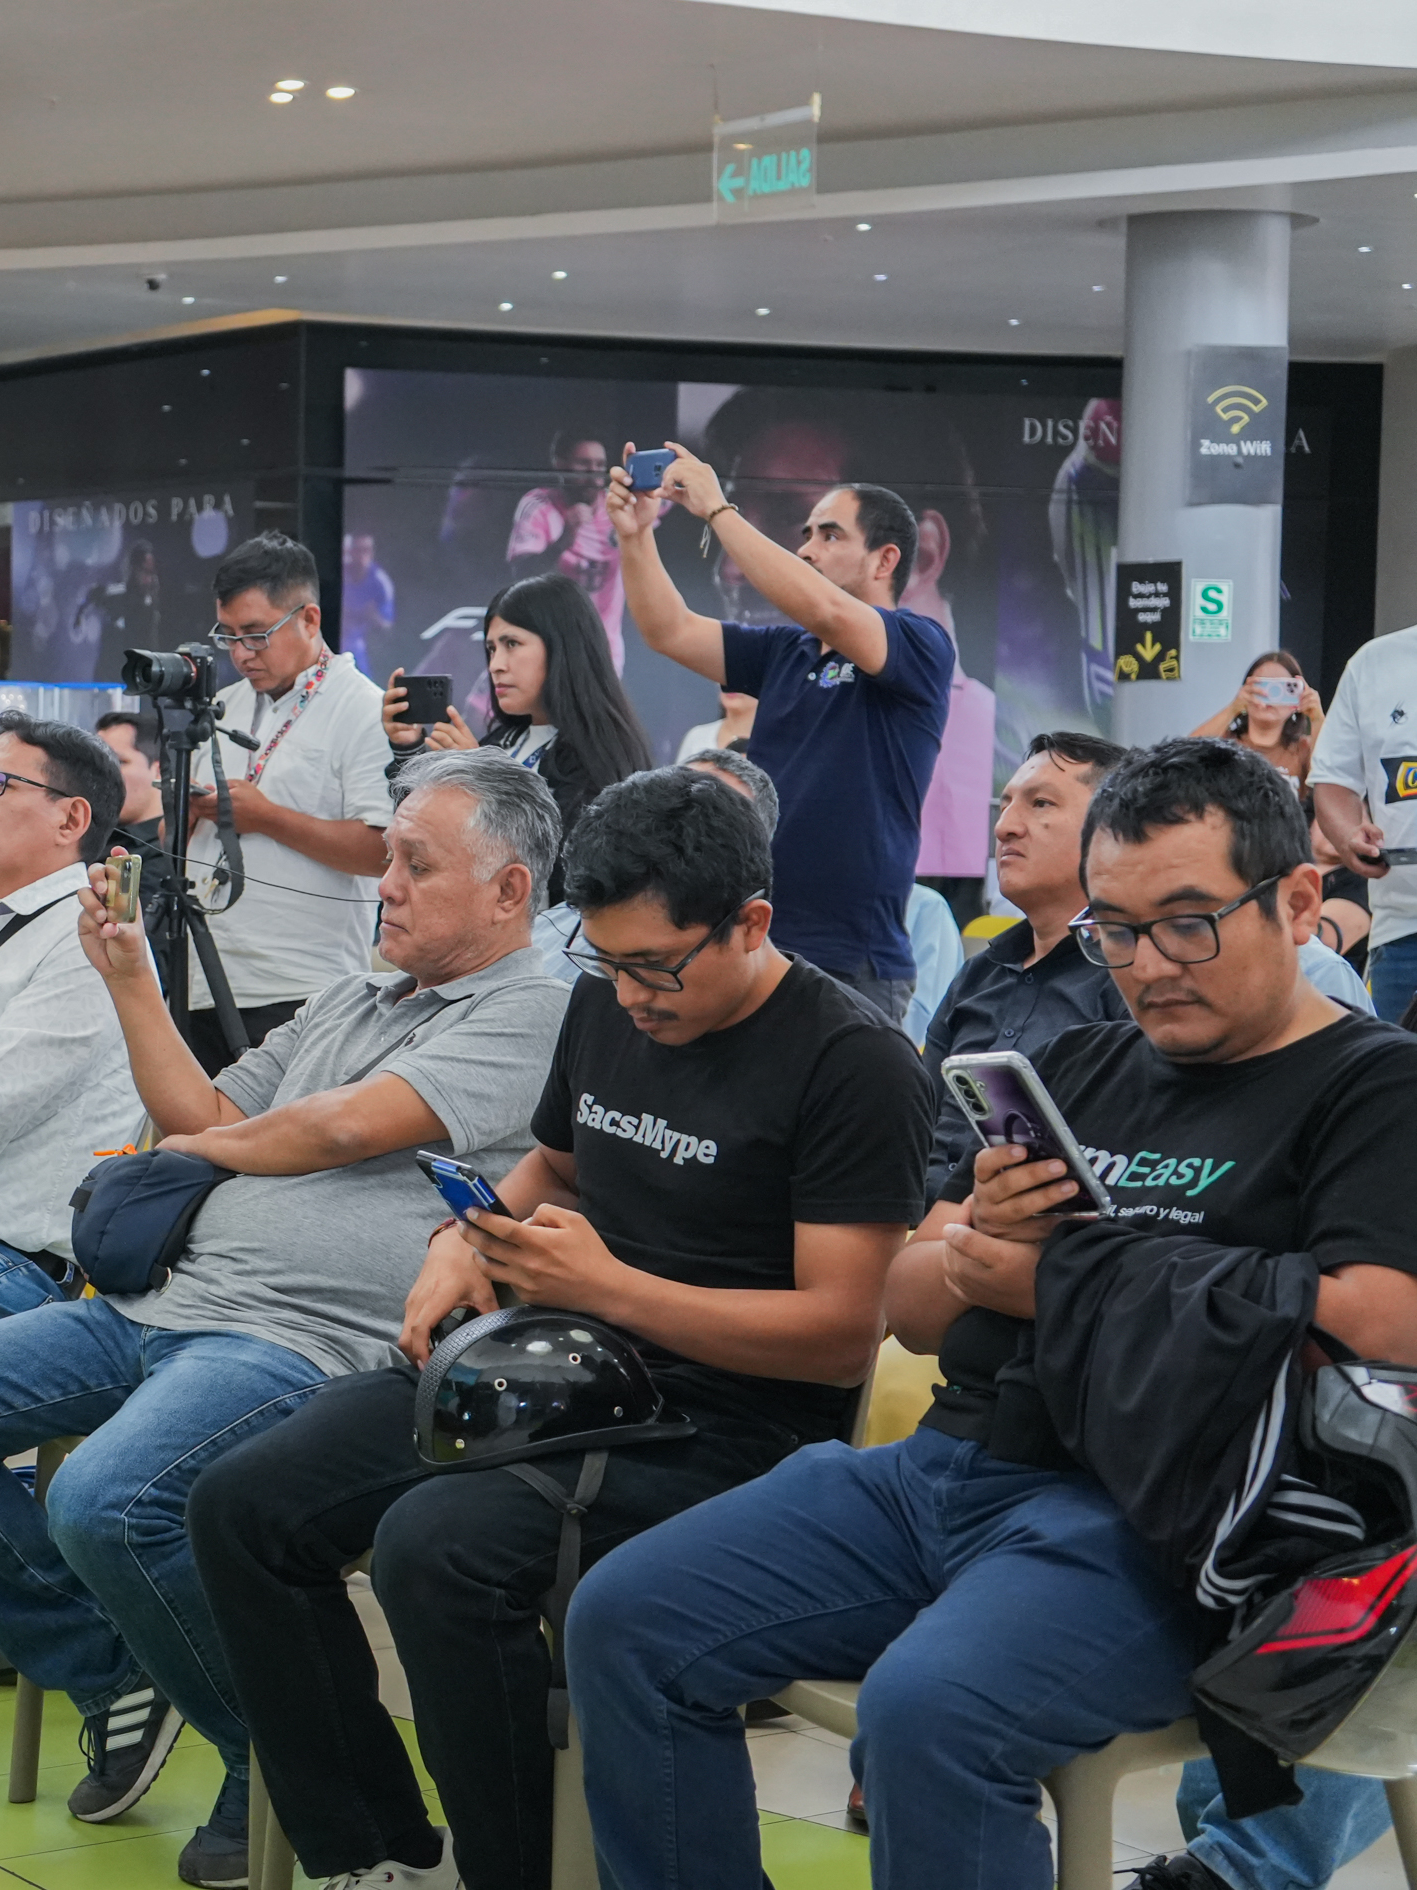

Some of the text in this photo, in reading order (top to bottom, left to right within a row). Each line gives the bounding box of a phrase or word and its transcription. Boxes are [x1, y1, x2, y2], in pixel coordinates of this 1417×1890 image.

[1200, 439, 1272, 457] Zona Wifi
[28, 492, 235, 535] DISEÑADOS PARA
[1131, 581, 1169, 596] Deja tu
[1200, 584, 1224, 615] S
[1128, 595, 1171, 610] bandeja
[576, 1093, 718, 1166] SacsMype
[1078, 1144, 1236, 1197] mEasy
[1157, 1207, 1170, 1220] y
[1168, 1207, 1204, 1225] legal
